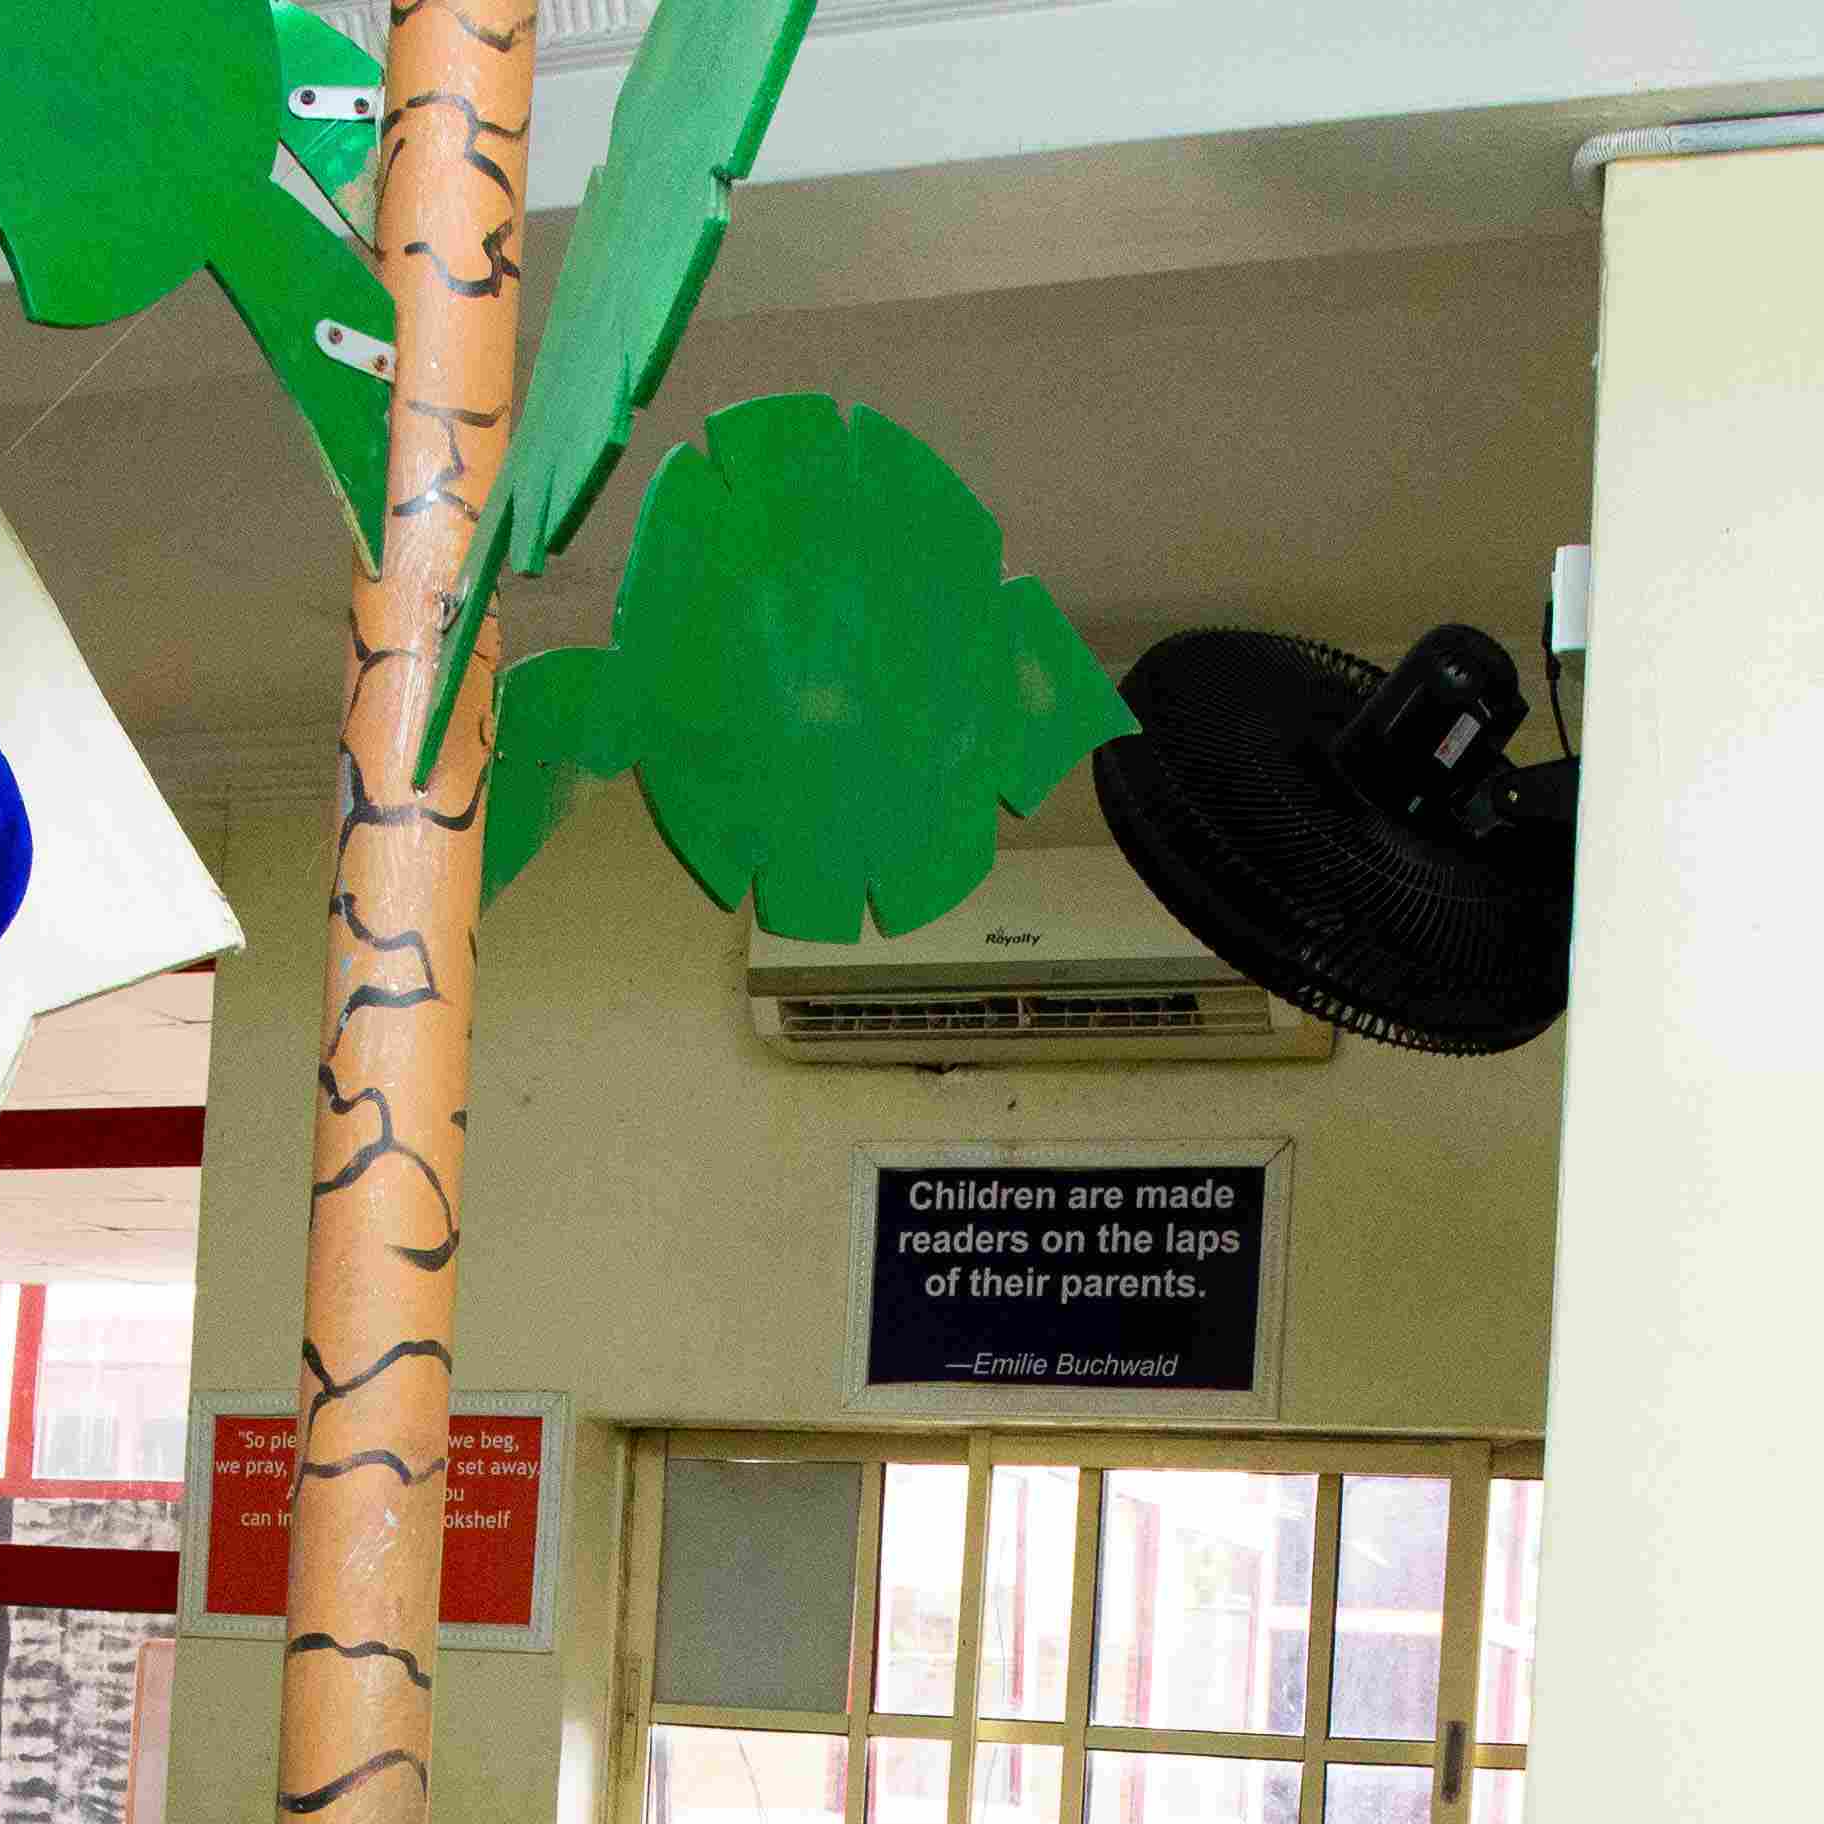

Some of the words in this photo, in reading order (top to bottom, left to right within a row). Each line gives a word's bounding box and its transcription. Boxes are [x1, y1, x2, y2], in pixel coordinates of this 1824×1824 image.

[985, 932, 1042, 947] Royalty
[908, 1180, 1057, 1211] Children
[1068, 1185, 1124, 1210] are
[1135, 1179, 1236, 1210] made
[898, 1223, 1030, 1254] readers
[1040, 1229, 1086, 1254] on
[1097, 1223, 1153, 1254] the
[1165, 1222, 1241, 1261] laps
[924, 1266, 962, 1298] of
[969, 1267, 1051, 1298] their
[1061, 1270, 1207, 1304] parents.
[1055, 1352, 1179, 1378] Buchwald
[238, 1430, 266, 1449] "So
[270, 1430, 298, 1454] ple
[449, 1433, 475, 1449] we
[480, 1430, 520, 1451] beg,
[215, 1459, 241, 1474] we
[245, 1457, 288, 1478] pray,
[457, 1457, 485, 1475] set
[443, 1486, 465, 1502] ou
[240, 1513, 271, 1528] can
[443, 1510, 512, 1529] okshelf
